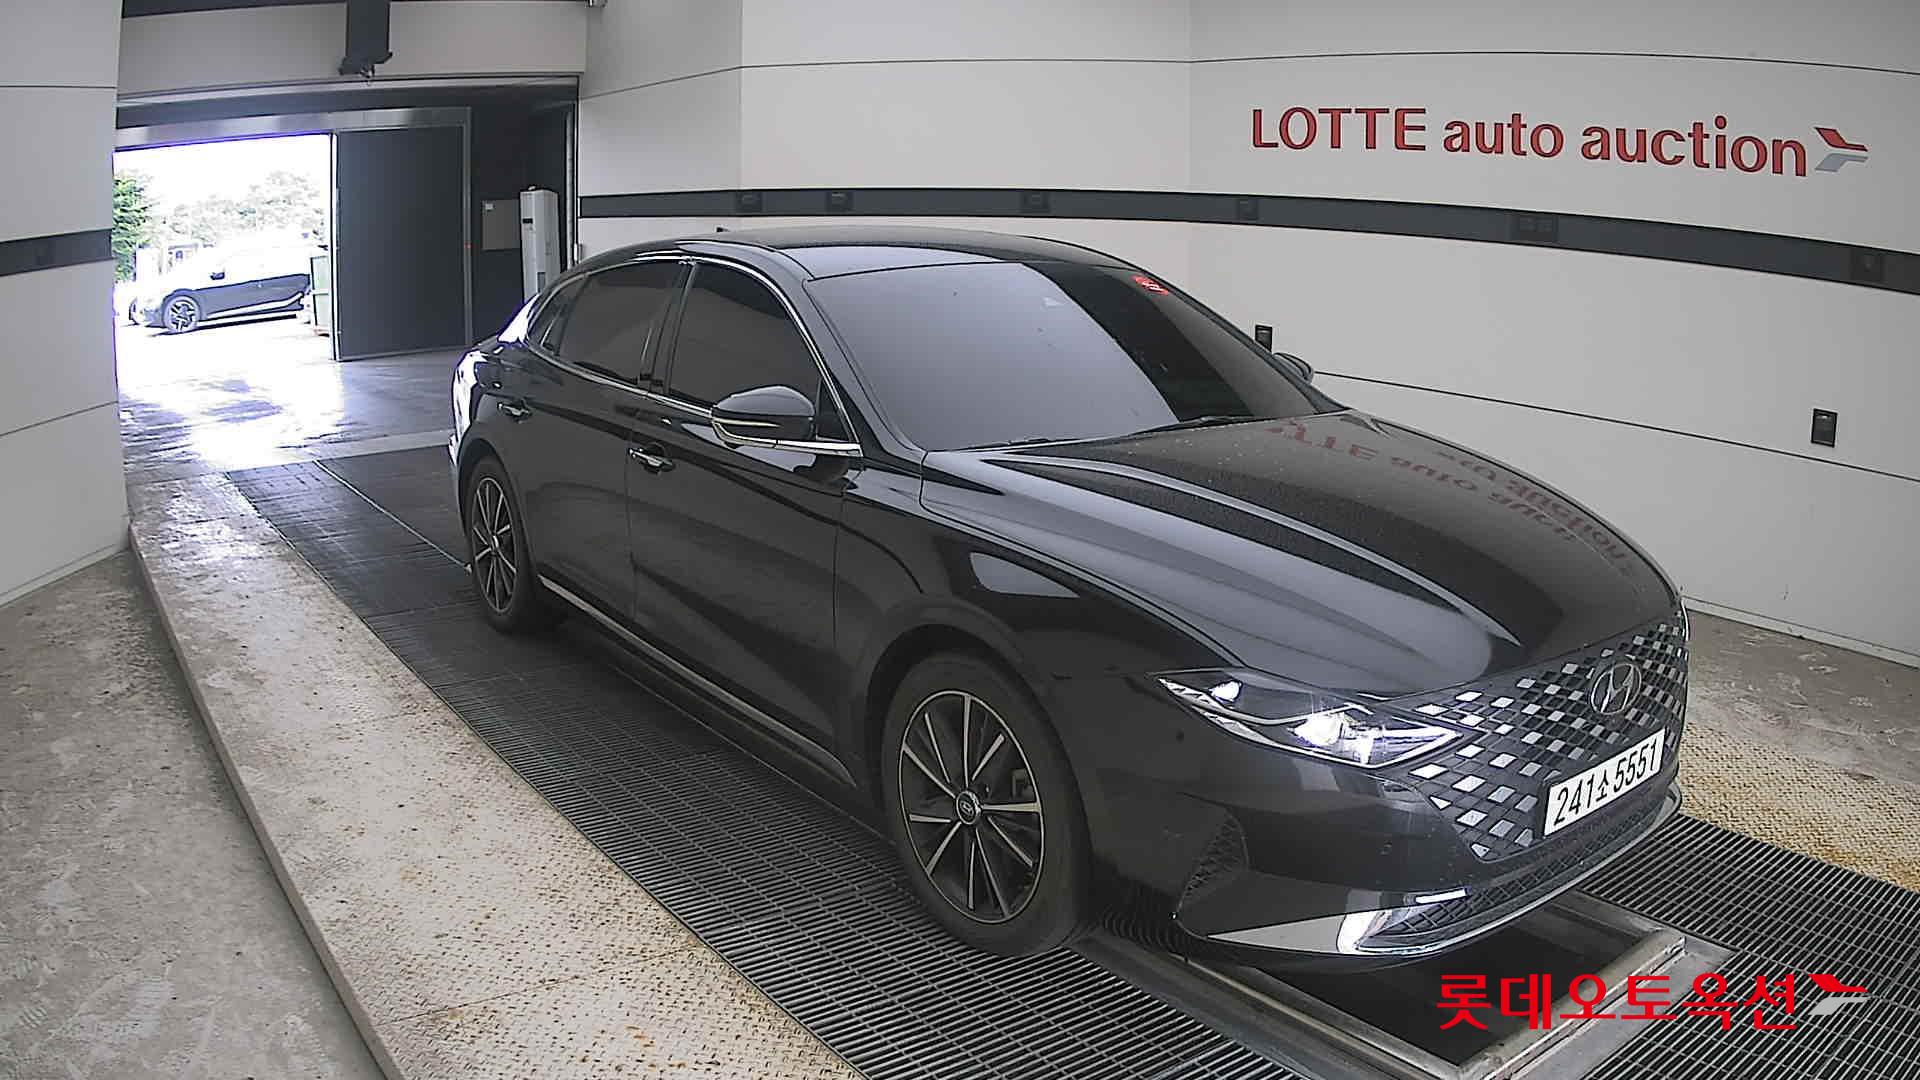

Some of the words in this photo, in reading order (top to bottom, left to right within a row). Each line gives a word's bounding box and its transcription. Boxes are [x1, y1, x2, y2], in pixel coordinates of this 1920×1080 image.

[1252, 107, 1426, 151] LOTTE
[1443, 113, 1564, 158] auto
[1581, 115, 1808, 178] auction
